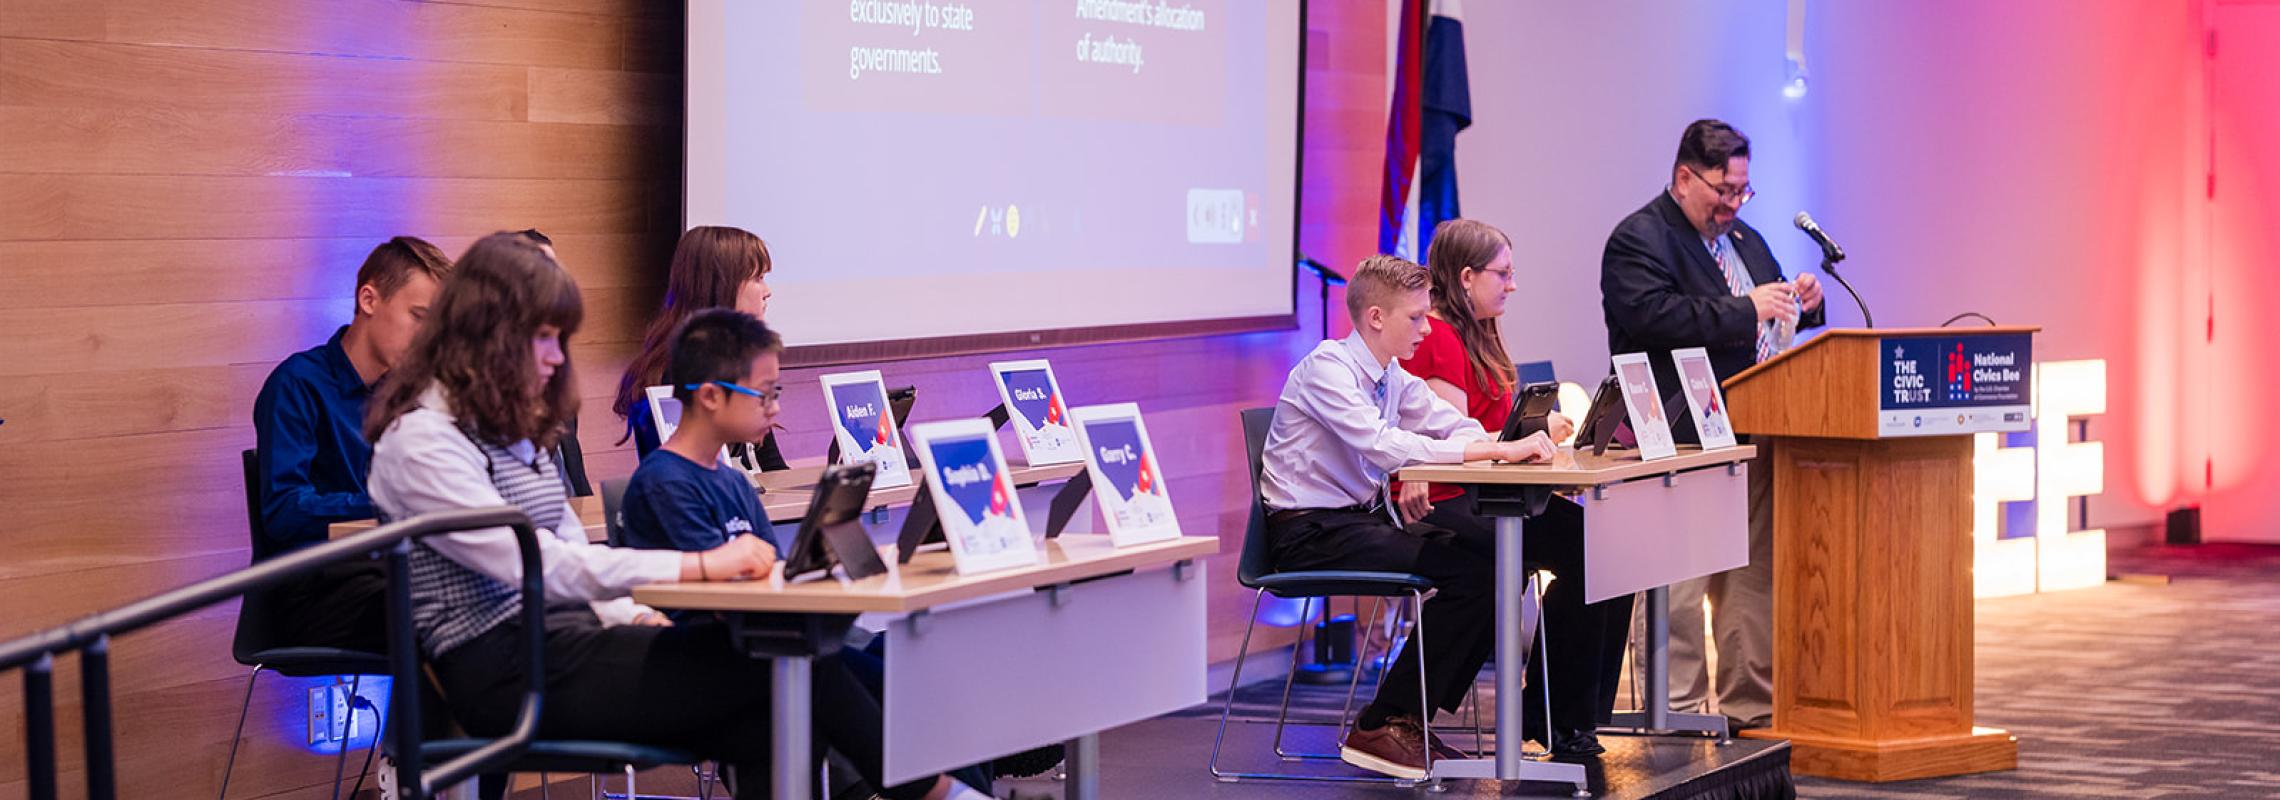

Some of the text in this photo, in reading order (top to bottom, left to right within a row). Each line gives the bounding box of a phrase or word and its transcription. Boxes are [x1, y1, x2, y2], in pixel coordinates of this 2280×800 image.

[850, 0, 974, 36] exclusively to state
[1153, 0, 1205, 31] allocation
[1076, 32, 1144, 74] of authority.
[850, 46, 943, 80] governments.
[1893, 359, 1917, 374] THE
[1974, 351, 2014, 367] National
[1893, 374, 1924, 388] CIVIC
[1973, 367, 2020, 383] Civics Bee
[1014, 388, 1038, 401] Gloria
[1893, 388, 1931, 404] TRUST
[846, 404, 869, 419] Aiden
[1100, 446, 1128, 465] Garry
